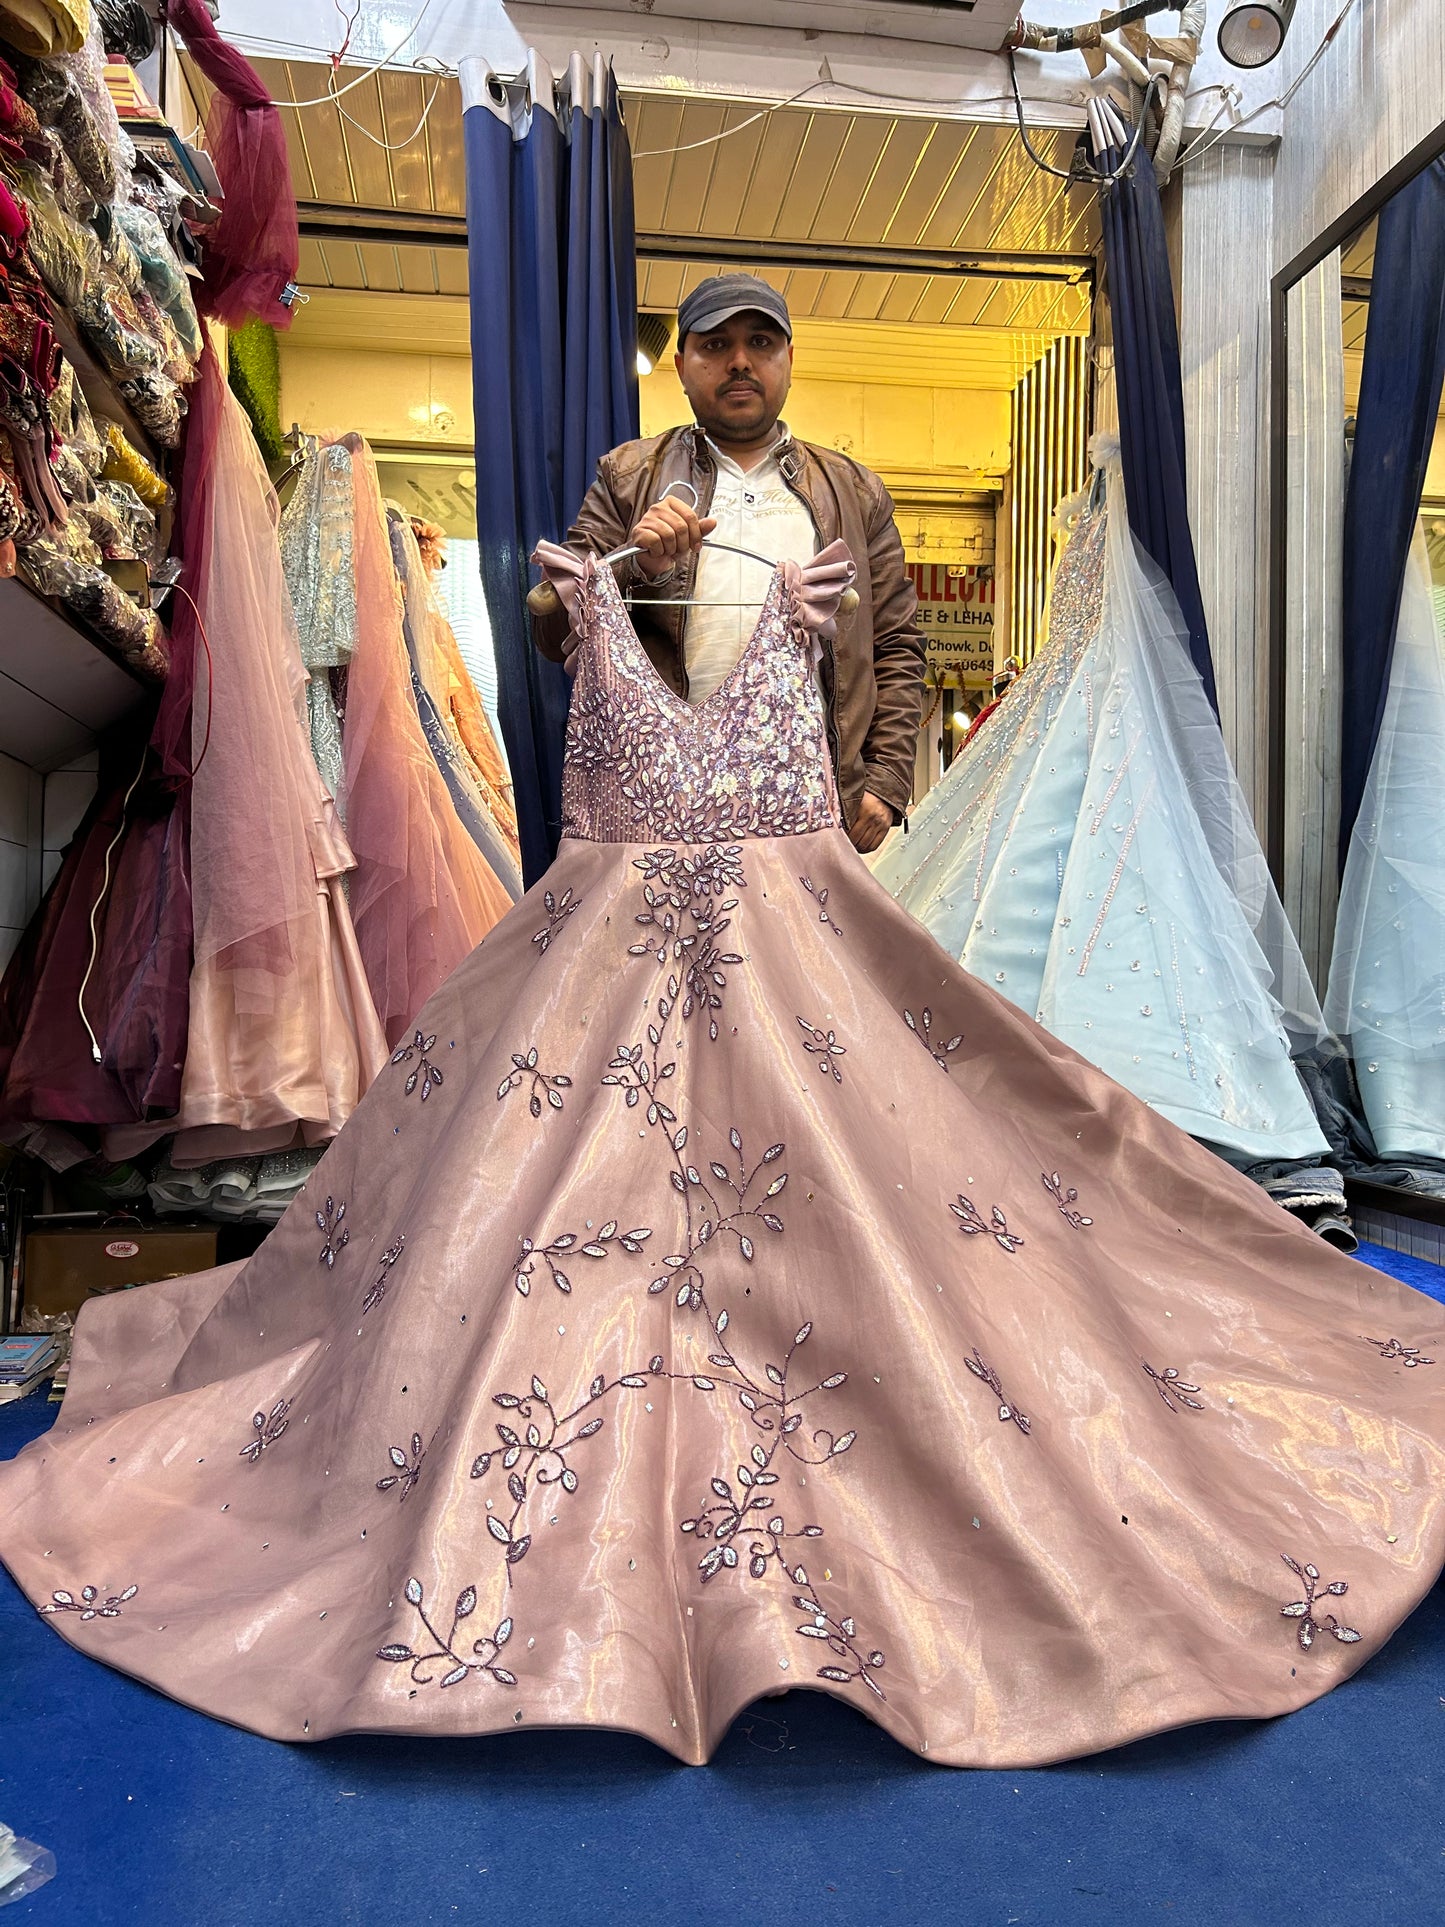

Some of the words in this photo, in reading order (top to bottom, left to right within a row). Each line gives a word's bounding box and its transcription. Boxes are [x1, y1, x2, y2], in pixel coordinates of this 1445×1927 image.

[937, 610, 949, 623] &
[954, 610, 994, 625] LEHA
[928, 639, 975, 653] Chowk,
